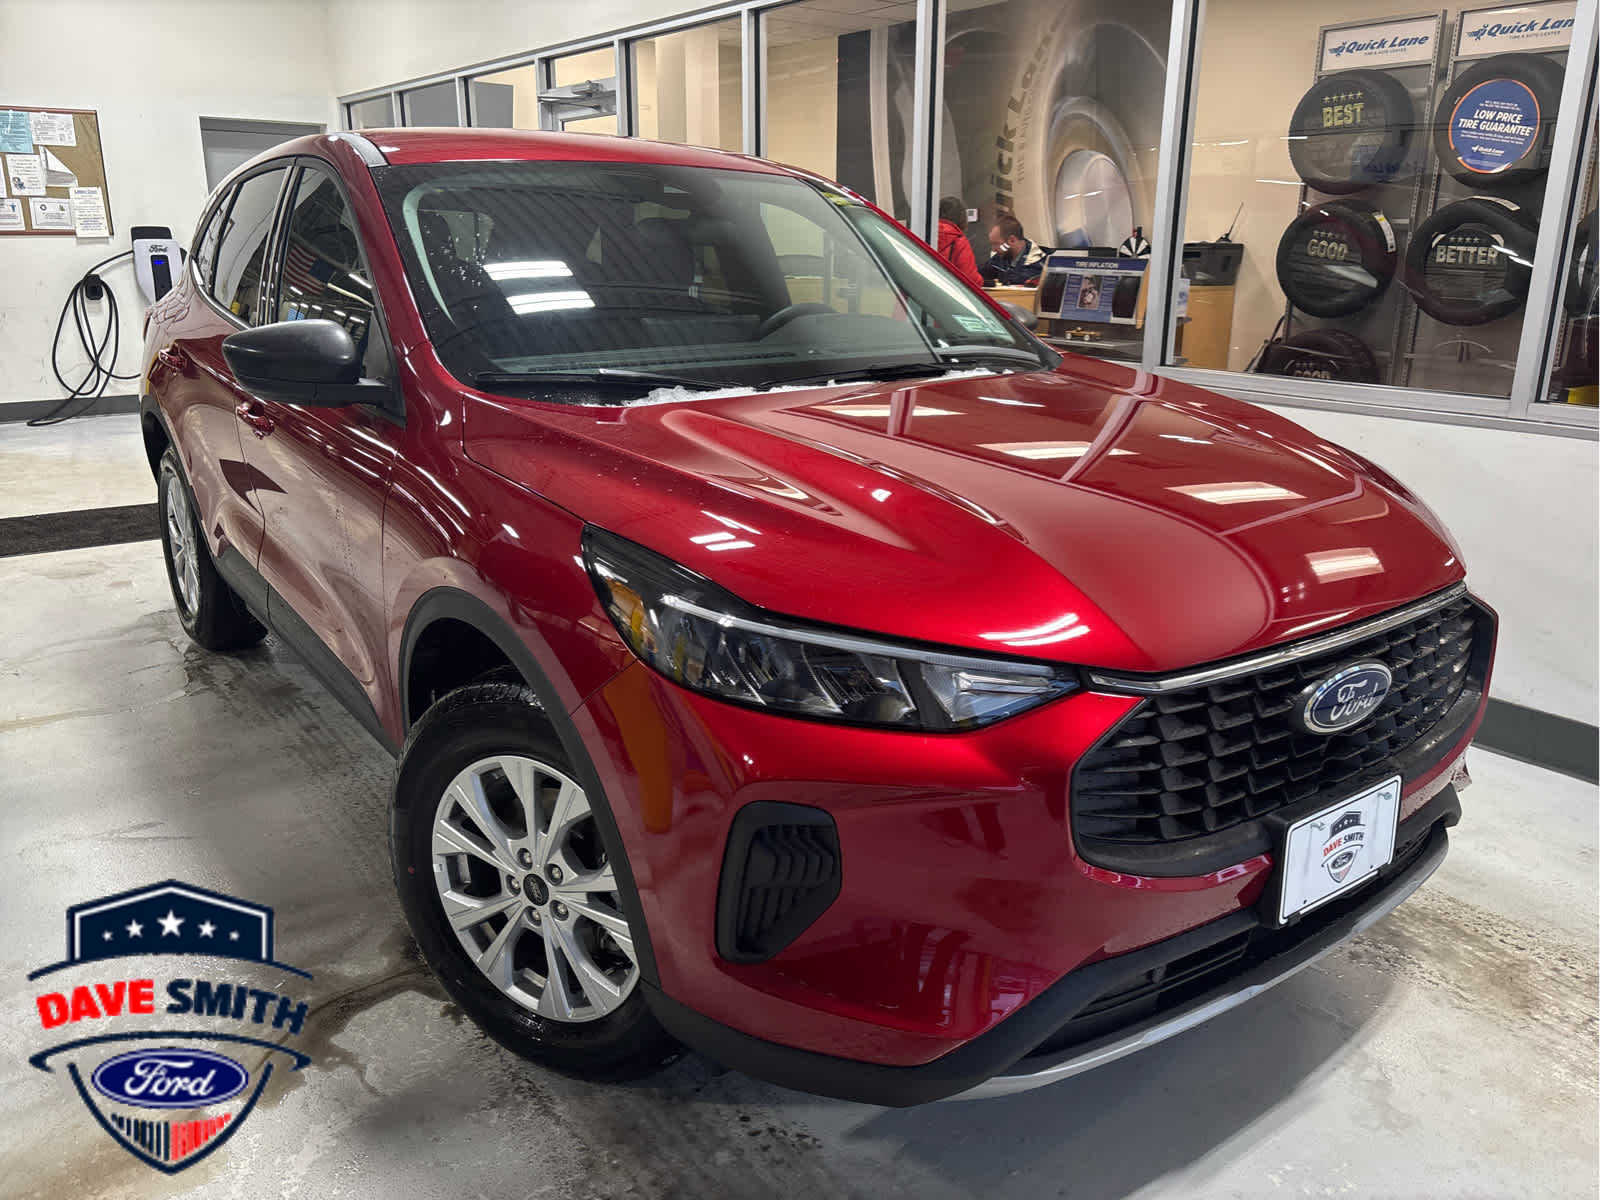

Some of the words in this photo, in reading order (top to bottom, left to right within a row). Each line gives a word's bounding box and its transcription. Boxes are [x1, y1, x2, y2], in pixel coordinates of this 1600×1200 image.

[1487, 19, 1539, 37] Quick
[1539, 17, 1576, 31] Lan
[1346, 38, 1388, 54] Quick
[1389, 36, 1429, 49] Lane
[1321, 102, 1365, 128] BEST
[1473, 109, 1496, 120] LOW
[1495, 110, 1523, 124] PRICE
[1458, 118, 1479, 129] TIRE
[1479, 120, 1532, 137] GUARANTEE
[1307, 239, 1349, 261] GOOD
[1436, 245, 1498, 265] BETTER
[1330, 679, 1379, 721] Ford
[1323, 837, 1343, 857] DAVE
[1343, 831, 1365, 845] SMITH
